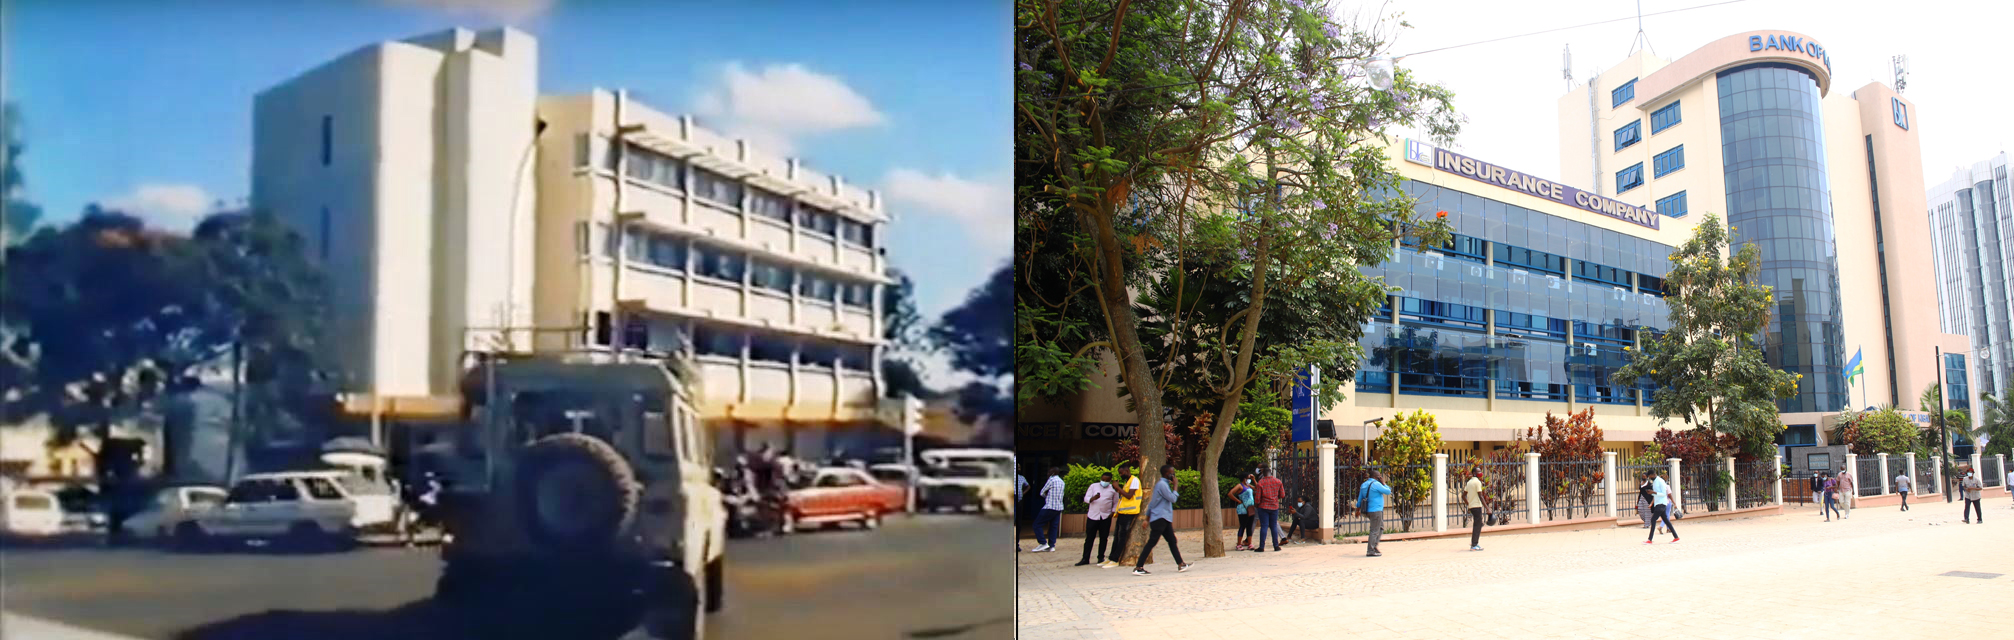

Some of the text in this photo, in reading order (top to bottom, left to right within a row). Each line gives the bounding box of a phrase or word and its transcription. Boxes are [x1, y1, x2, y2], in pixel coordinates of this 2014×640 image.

[1749, 34, 1823, 59] BANK OF
[1437, 150, 1659, 227] INSURANCE COMPANY
